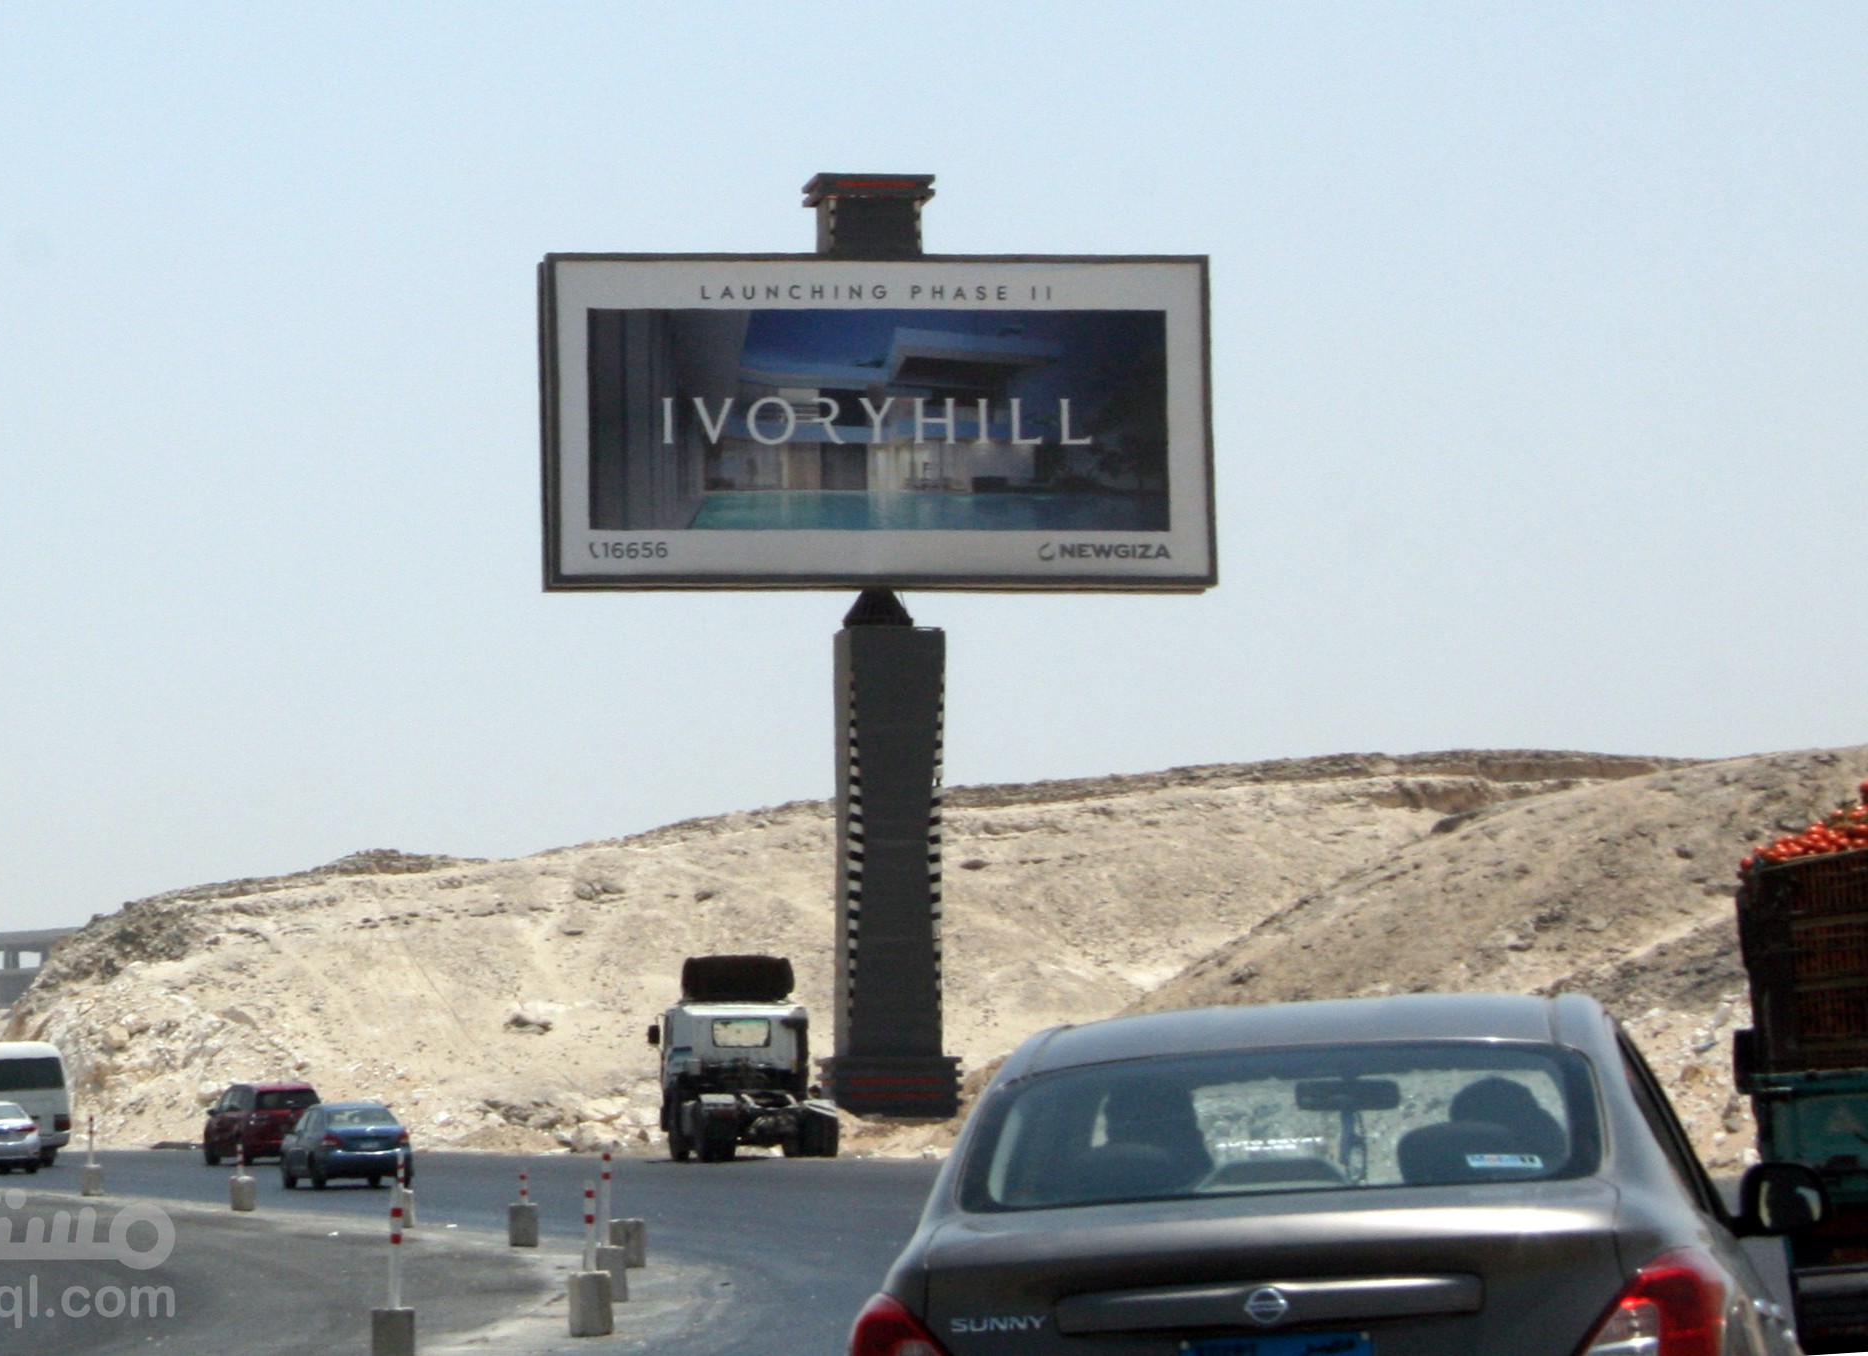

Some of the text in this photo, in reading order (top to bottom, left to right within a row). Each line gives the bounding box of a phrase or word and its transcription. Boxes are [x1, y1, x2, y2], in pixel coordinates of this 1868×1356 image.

[700, 284, 1052, 301] LAUNCHING PHASE II
[661, 396, 1093, 446] IVORYHILL
[601, 541, 668, 559] 16656
[1059, 543, 1171, 559] NEWGIZA
[950, 1315, 1048, 1333] SUNNY
